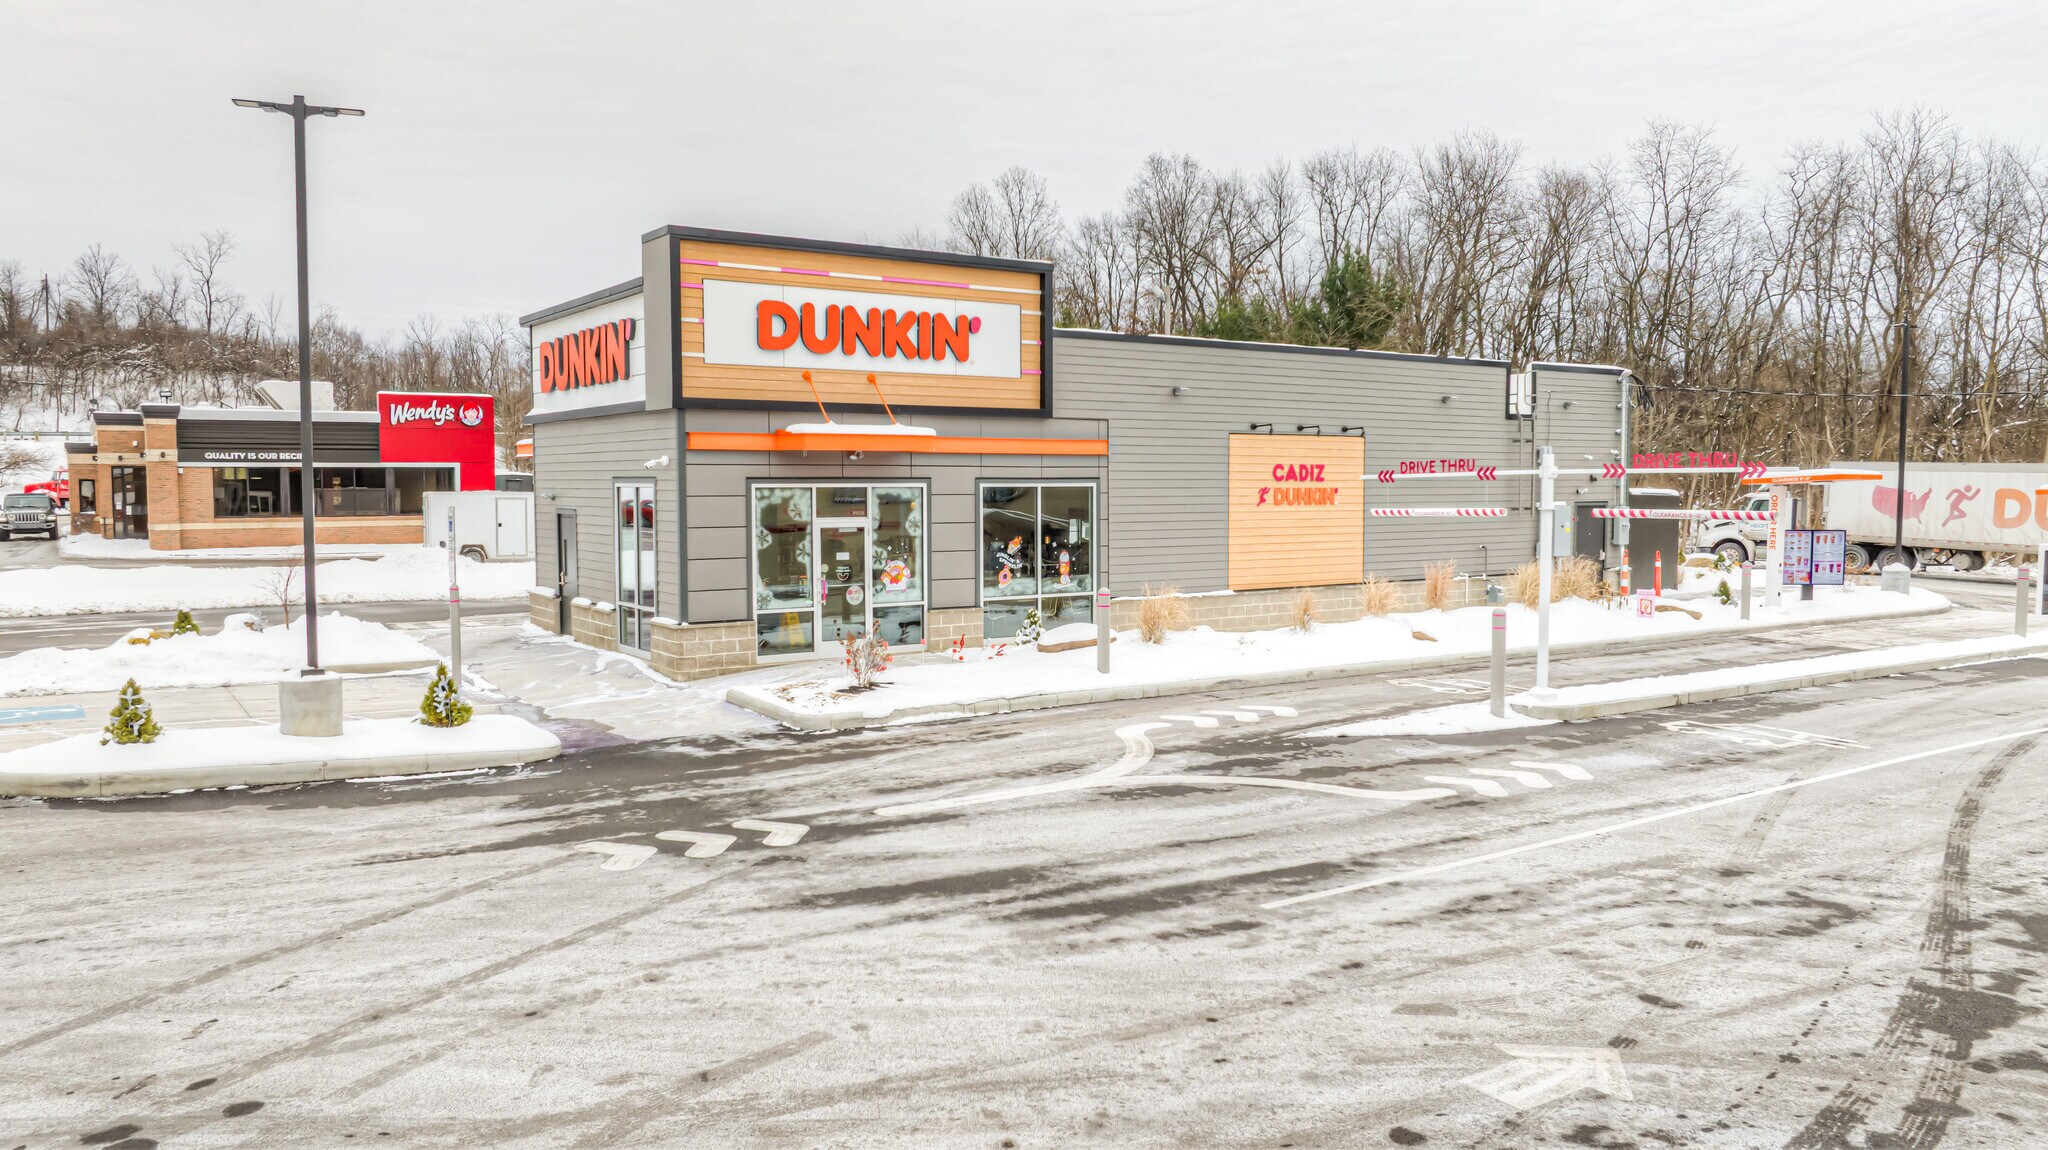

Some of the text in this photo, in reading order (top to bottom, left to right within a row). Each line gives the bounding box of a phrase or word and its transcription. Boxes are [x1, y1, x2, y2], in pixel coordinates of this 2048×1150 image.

[757, 300, 982, 363] DUNKIN'
[540, 317, 636, 394] DUNKIN'
[390, 400, 455, 426] Wendy's
[205, 452, 246, 460] QUALITY
[248, 452, 257, 460] IS
[258, 452, 278, 460] OUR
[1632, 451, 1738, 468] DRIVE THRU
[1272, 463, 1325, 482] CADIZ
[1400, 458, 1476, 475] DRIVE THRU
[1273, 487, 1338, 506] DUNKIN'
[1769, 527, 1777, 550] HERE
